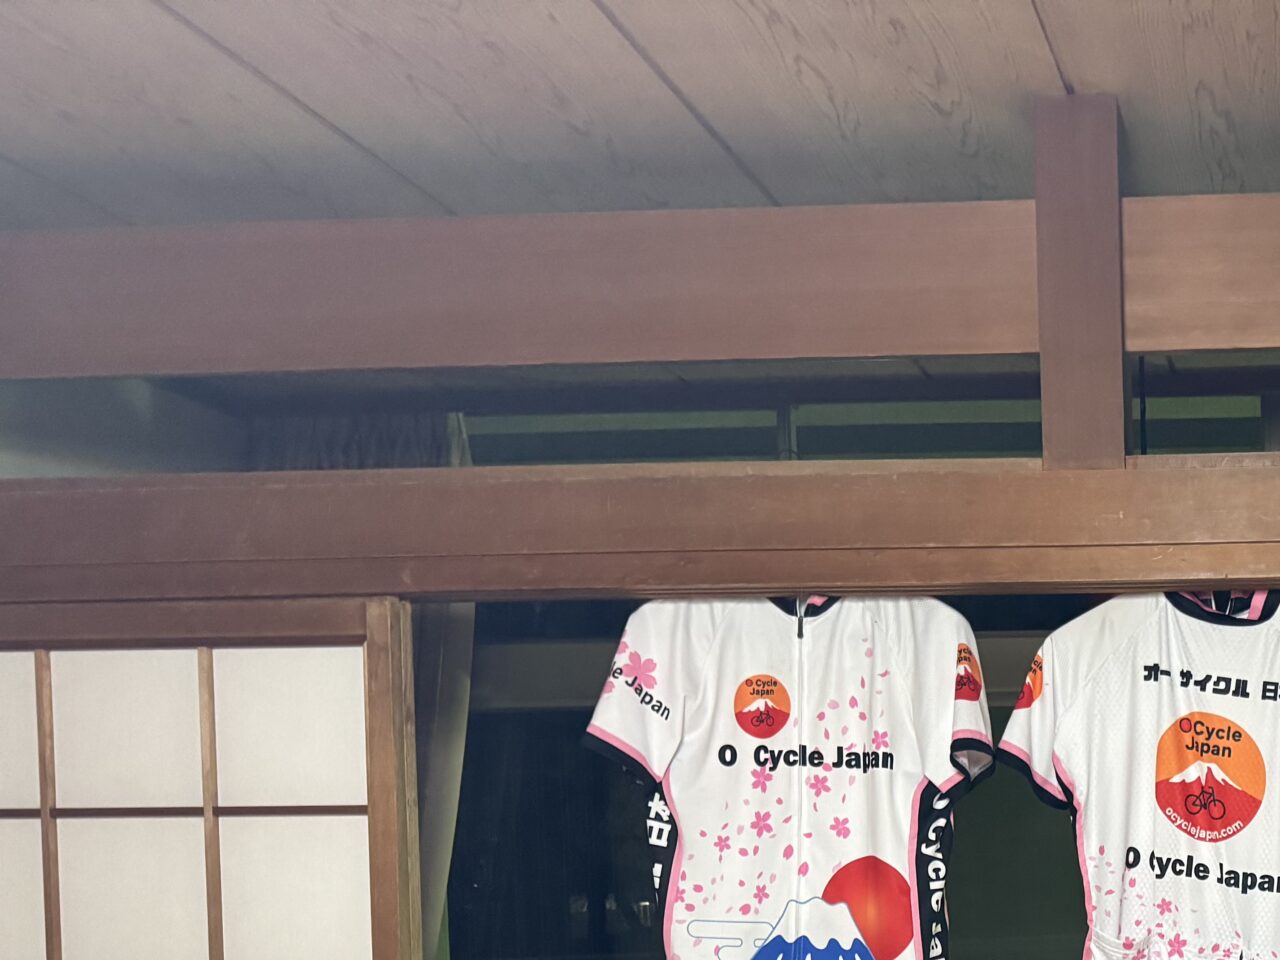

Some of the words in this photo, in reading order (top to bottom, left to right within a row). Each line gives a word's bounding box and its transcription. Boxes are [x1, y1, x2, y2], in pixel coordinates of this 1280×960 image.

[749, 687, 775, 698] Japan
[755, 678, 778, 688] Cycle
[1179, 668, 1250, 699] サイクル
[624, 676, 671, 720] Japan
[717, 743, 738, 767] O
[753, 743, 824, 772] Cycle
[832, 745, 894, 773] Japan
[1124, 846, 1141, 869] O
